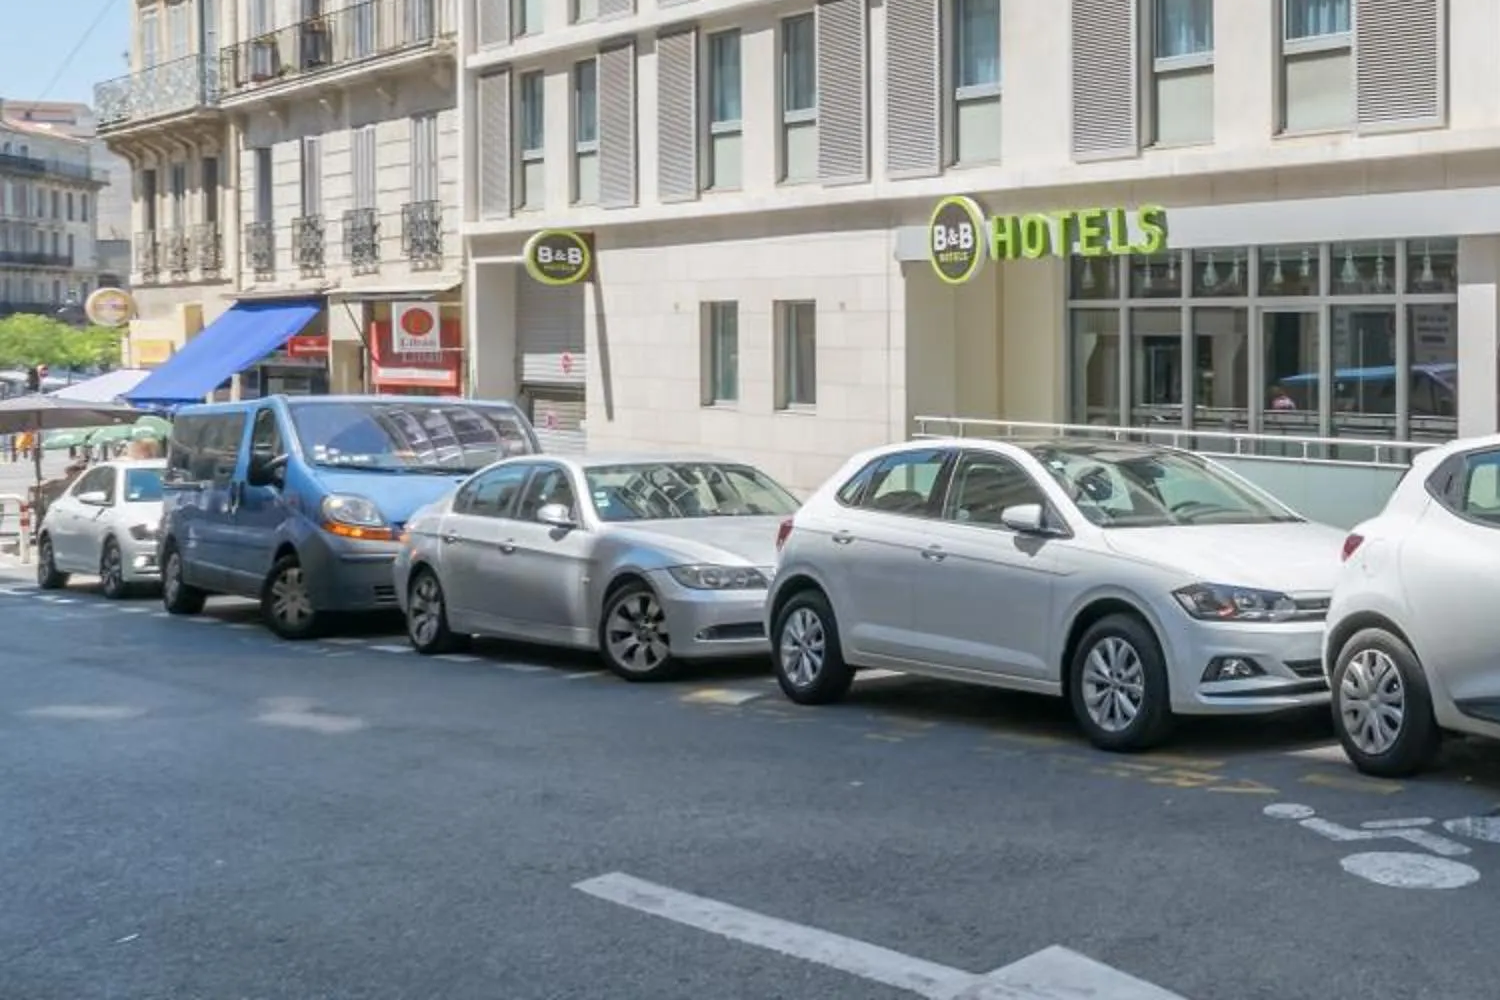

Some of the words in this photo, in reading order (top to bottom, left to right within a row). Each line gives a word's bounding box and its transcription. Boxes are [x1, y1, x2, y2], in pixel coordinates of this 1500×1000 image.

[933, 222, 974, 251] B&B
[991, 205, 1168, 260] HOTELS
[537, 246, 583, 264] B&B
